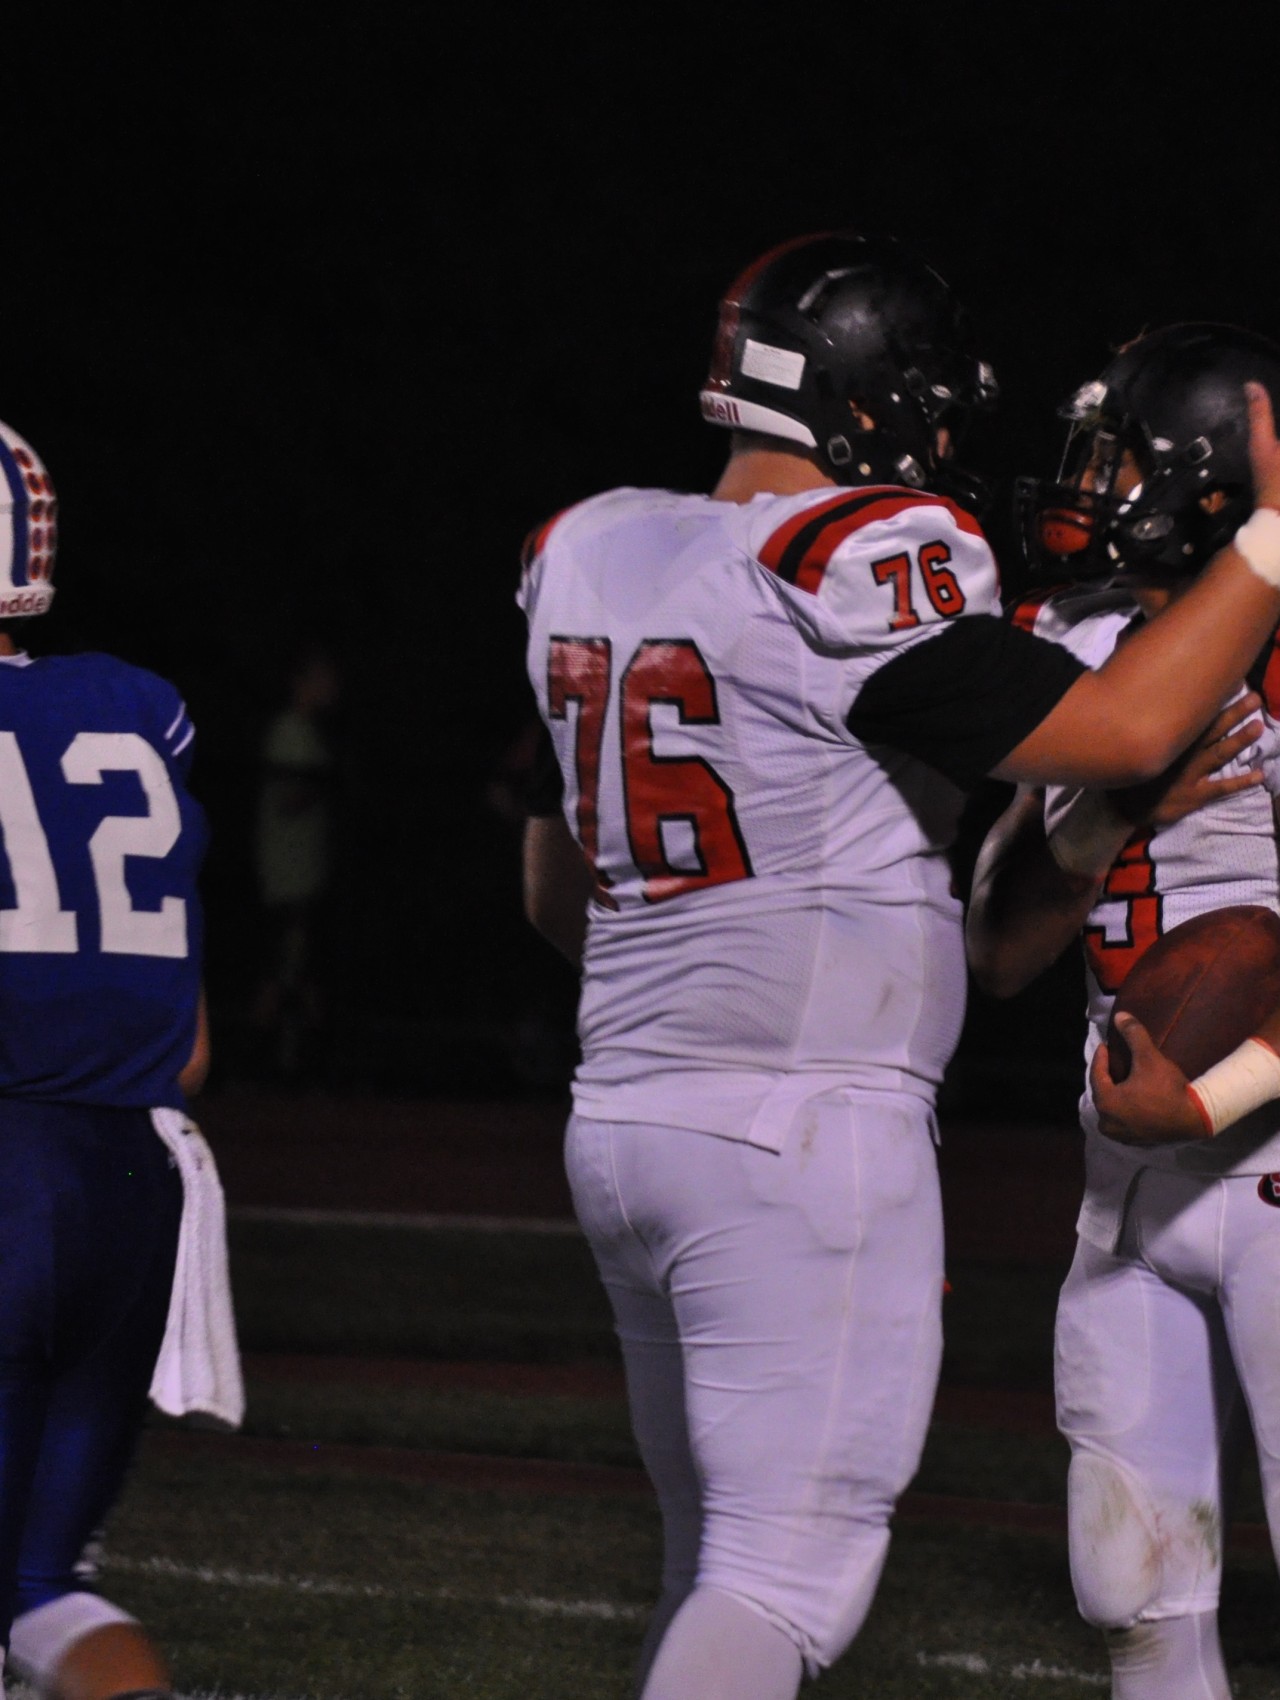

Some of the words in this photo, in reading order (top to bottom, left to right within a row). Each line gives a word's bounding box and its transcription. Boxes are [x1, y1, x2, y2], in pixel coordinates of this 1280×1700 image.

[871, 540, 966, 631] 76
[0, 731, 189, 959] 12
[547, 636, 755, 912] 76
